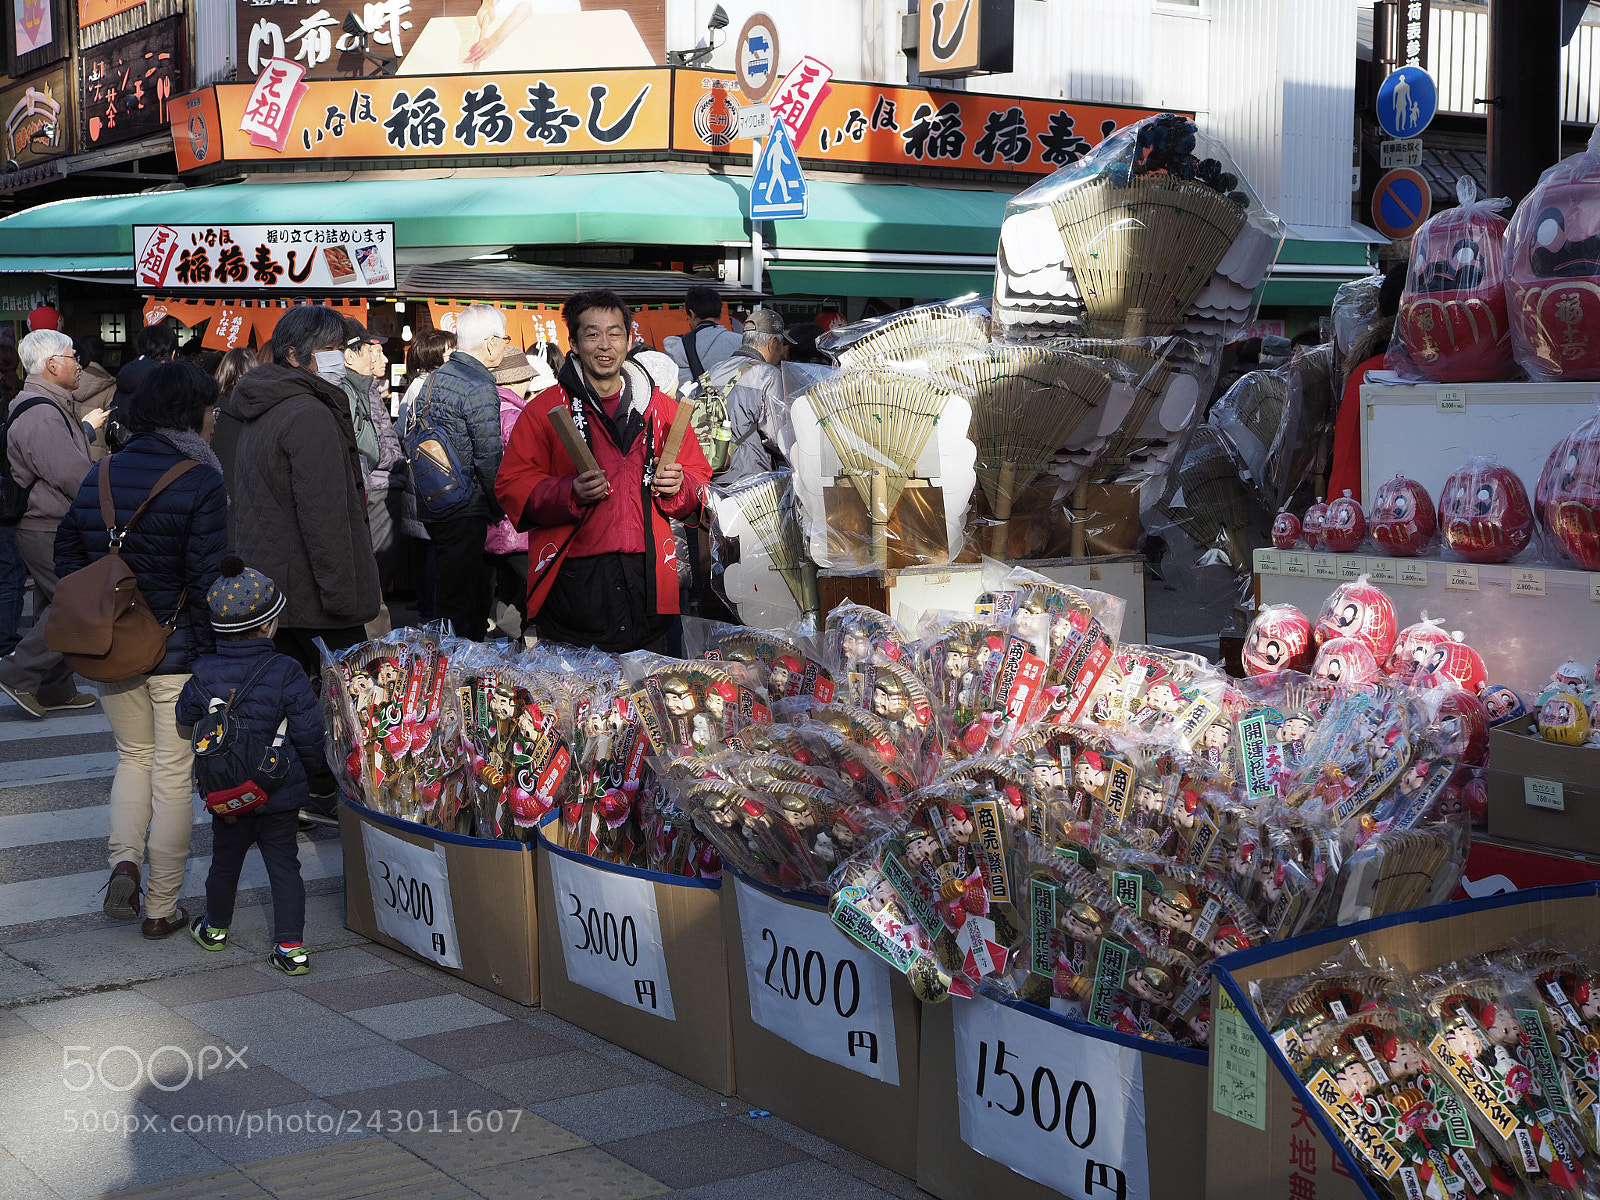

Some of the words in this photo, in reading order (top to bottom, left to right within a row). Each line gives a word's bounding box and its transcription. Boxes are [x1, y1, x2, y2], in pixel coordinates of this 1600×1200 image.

[1405, 0, 1422, 67] 荷表参
[246, 67, 288, 134] 元祖
[303, 89, 377, 151] いなほ
[382, 80, 653, 149] 稲荷寿し
[770, 64, 820, 131] 元祖
[820, 96, 899, 152] いなほ
[901, 103, 1116, 168] 稲荷寿
[141, 230, 170, 276] 元祖
[192, 228, 235, 247] いなほ
[266, 228, 387, 244] 握り立てお詰めします
[175, 243, 319, 286] 稲荷寿し
[216, 309, 233, 337] いなほ
[431, 932, 446, 956] 円
[634, 979, 656, 1009] 円
[761, 927, 860, 1018] 2,000
[847, 1030, 878, 1063] 円
[1435, 1043, 1512, 1131] 家内安全
[1314, 1076, 1398, 1172] 家内安全
[1085, 1159, 1126, 1200] 円
